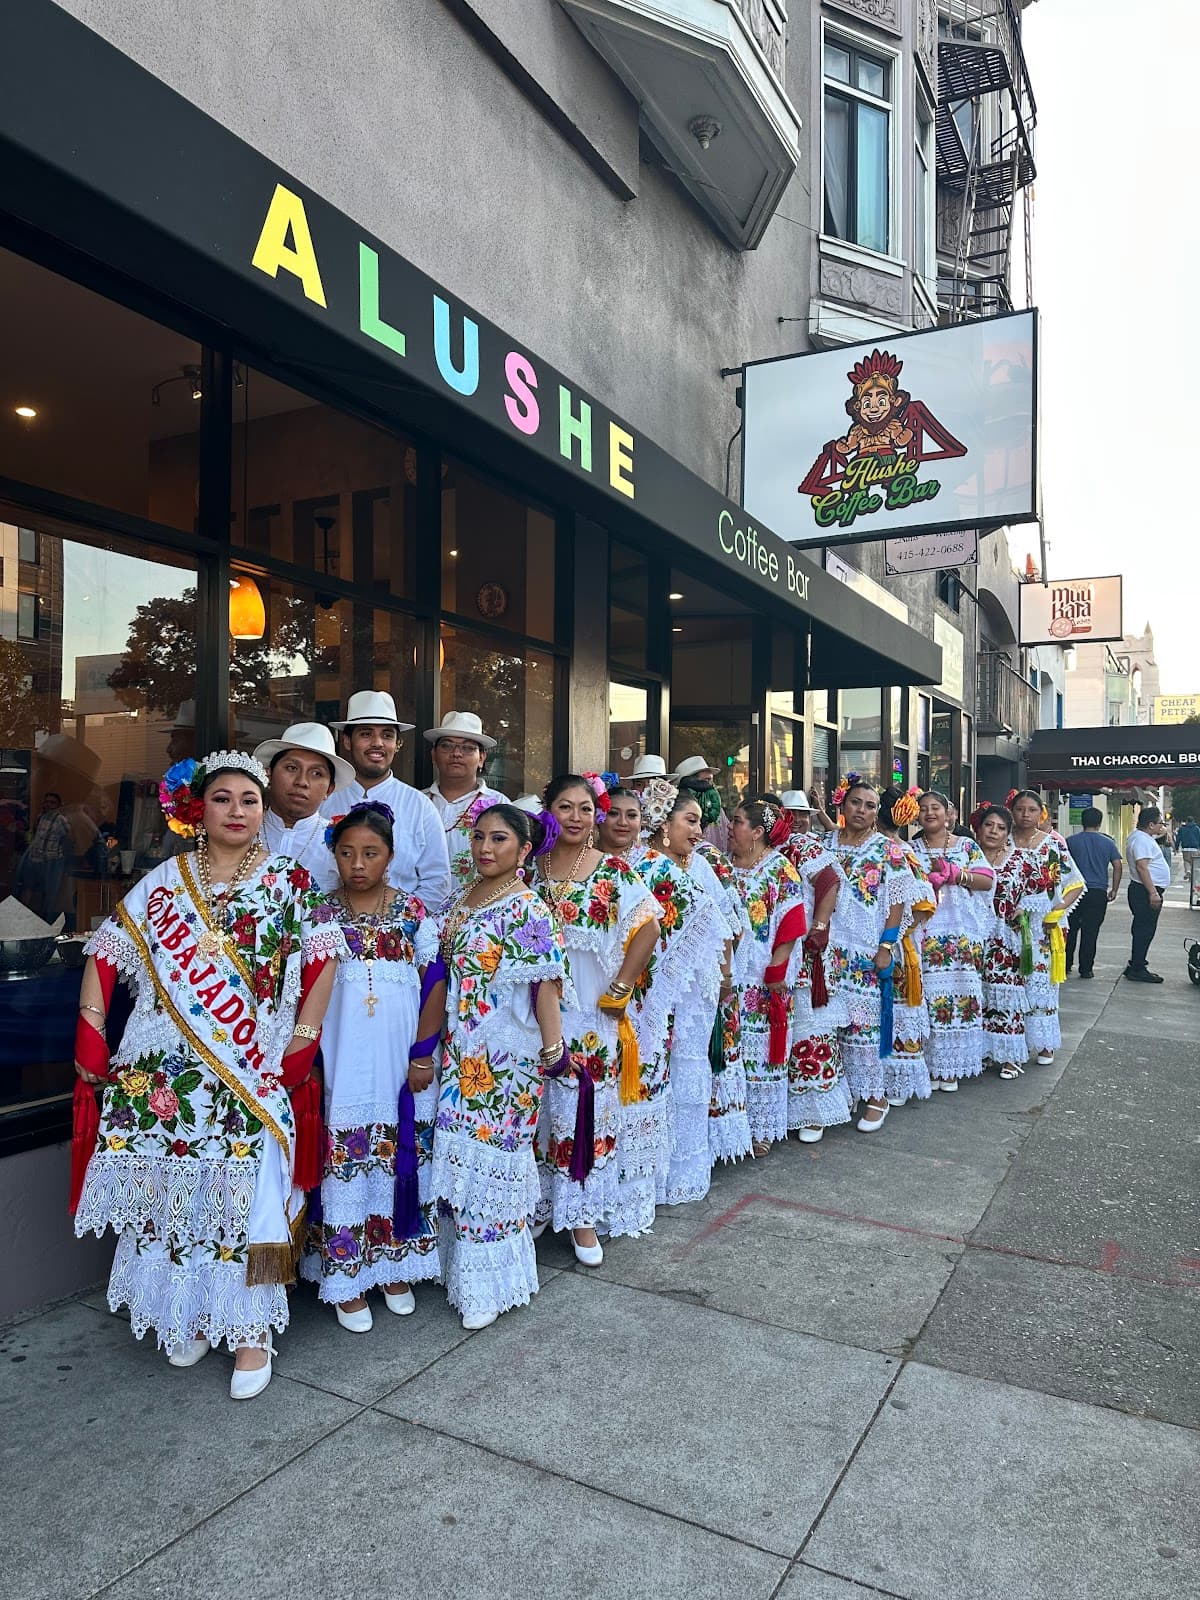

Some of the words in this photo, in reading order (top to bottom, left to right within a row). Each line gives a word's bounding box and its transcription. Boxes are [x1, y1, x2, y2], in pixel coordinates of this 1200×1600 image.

[251, 183, 635, 499] ALUSHE
[841, 453, 919, 490] Alushe
[812, 491, 882, 525] Coffee
[887, 476, 941, 507] Bar
[717, 510, 779, 583] Coffee
[787, 555, 810, 601] Bar
[897, 543, 964, 560] 415-422-0688
[1161, 698, 1196, 707] CHEAP
[1161, 708, 1196, 716] PETE'S
[1071, 756, 1100, 766] THAI
[1102, 754, 1176, 766] CHARCOAL
[1178, 753, 1200, 764] BB
